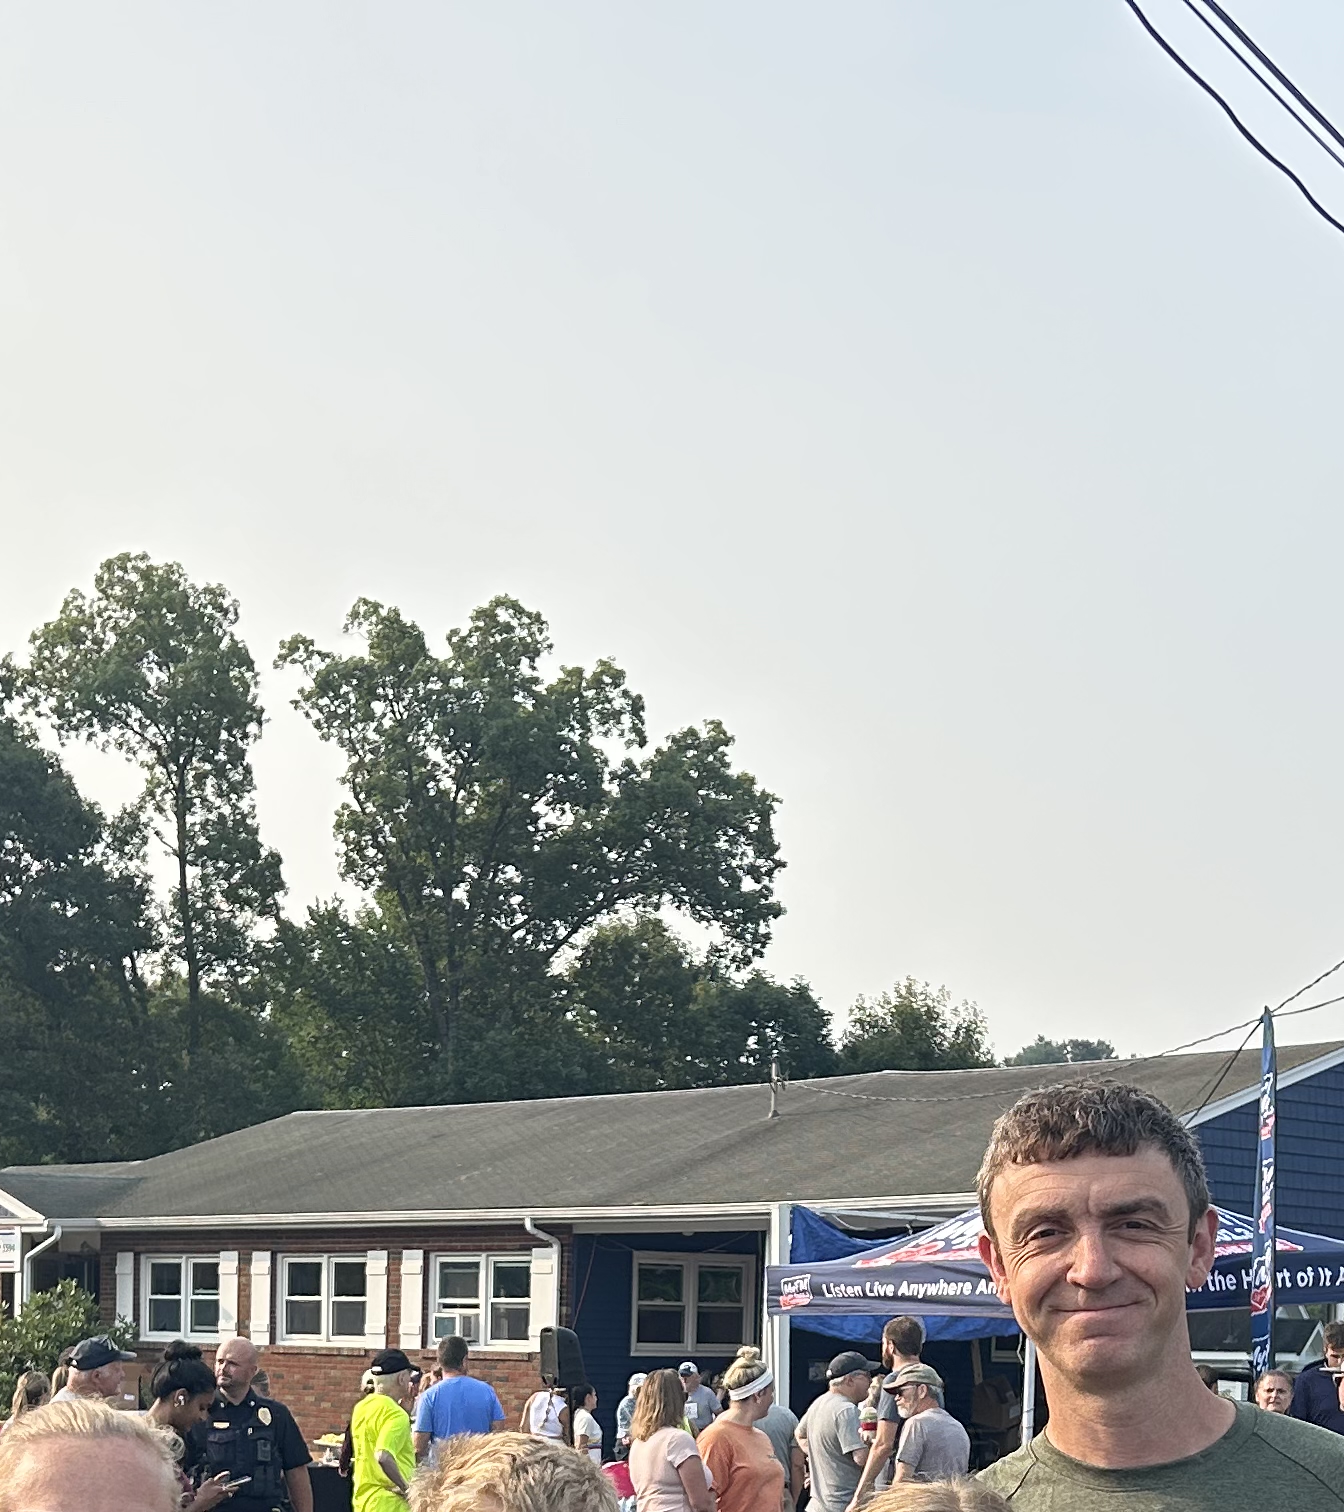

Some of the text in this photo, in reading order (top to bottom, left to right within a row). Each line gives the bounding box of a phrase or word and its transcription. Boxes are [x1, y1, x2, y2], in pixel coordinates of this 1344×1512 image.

[821, 1283, 862, 1298] Listen
[865, 1281, 895, 1297] Live
[897, 1278, 972, 1299] Anywhere
[1207, 1268, 1237, 1290] the
[1243, 1265, 1292, 1289] Hrt
[1296, 1266, 1313, 1288] of
